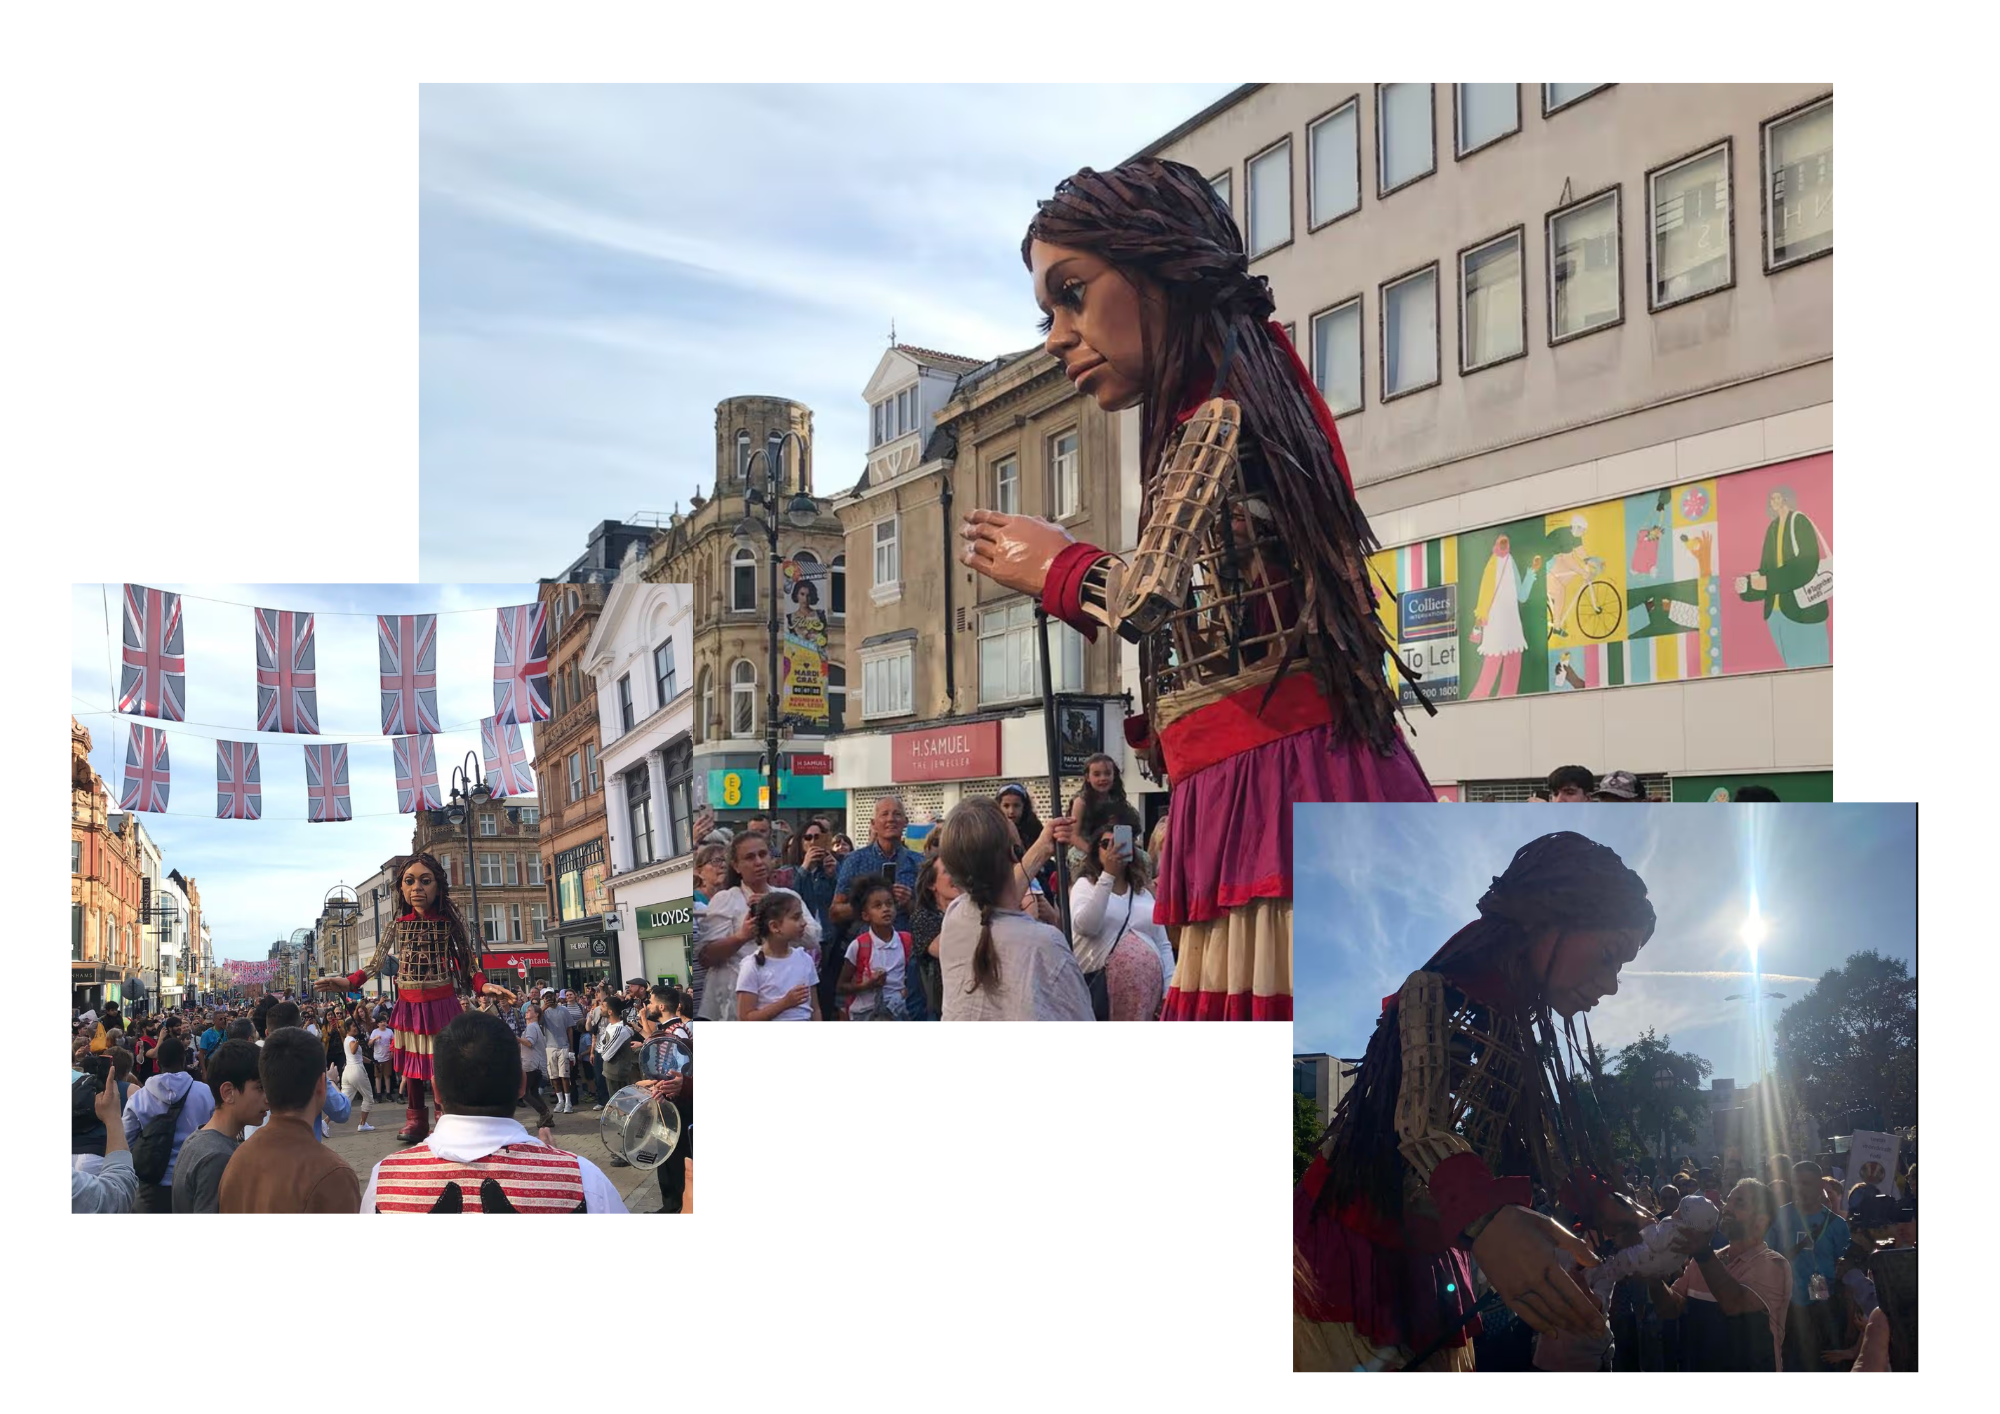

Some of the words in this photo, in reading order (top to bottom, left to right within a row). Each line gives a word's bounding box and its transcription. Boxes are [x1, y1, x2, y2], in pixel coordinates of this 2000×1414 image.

[1408, 598, 1450, 614] Colliers
[1403, 648, 1423, 669] To
[1430, 645, 1455, 667] Let
[794, 669, 819, 677] MARDI
[796, 676, 817, 684] GRAS
[1403, 689, 1418, 700] 011
[912, 734, 970, 757] H.SAMUEL
[912, 762, 926, 770] THE
[651, 908, 690, 927] LLOYDS
